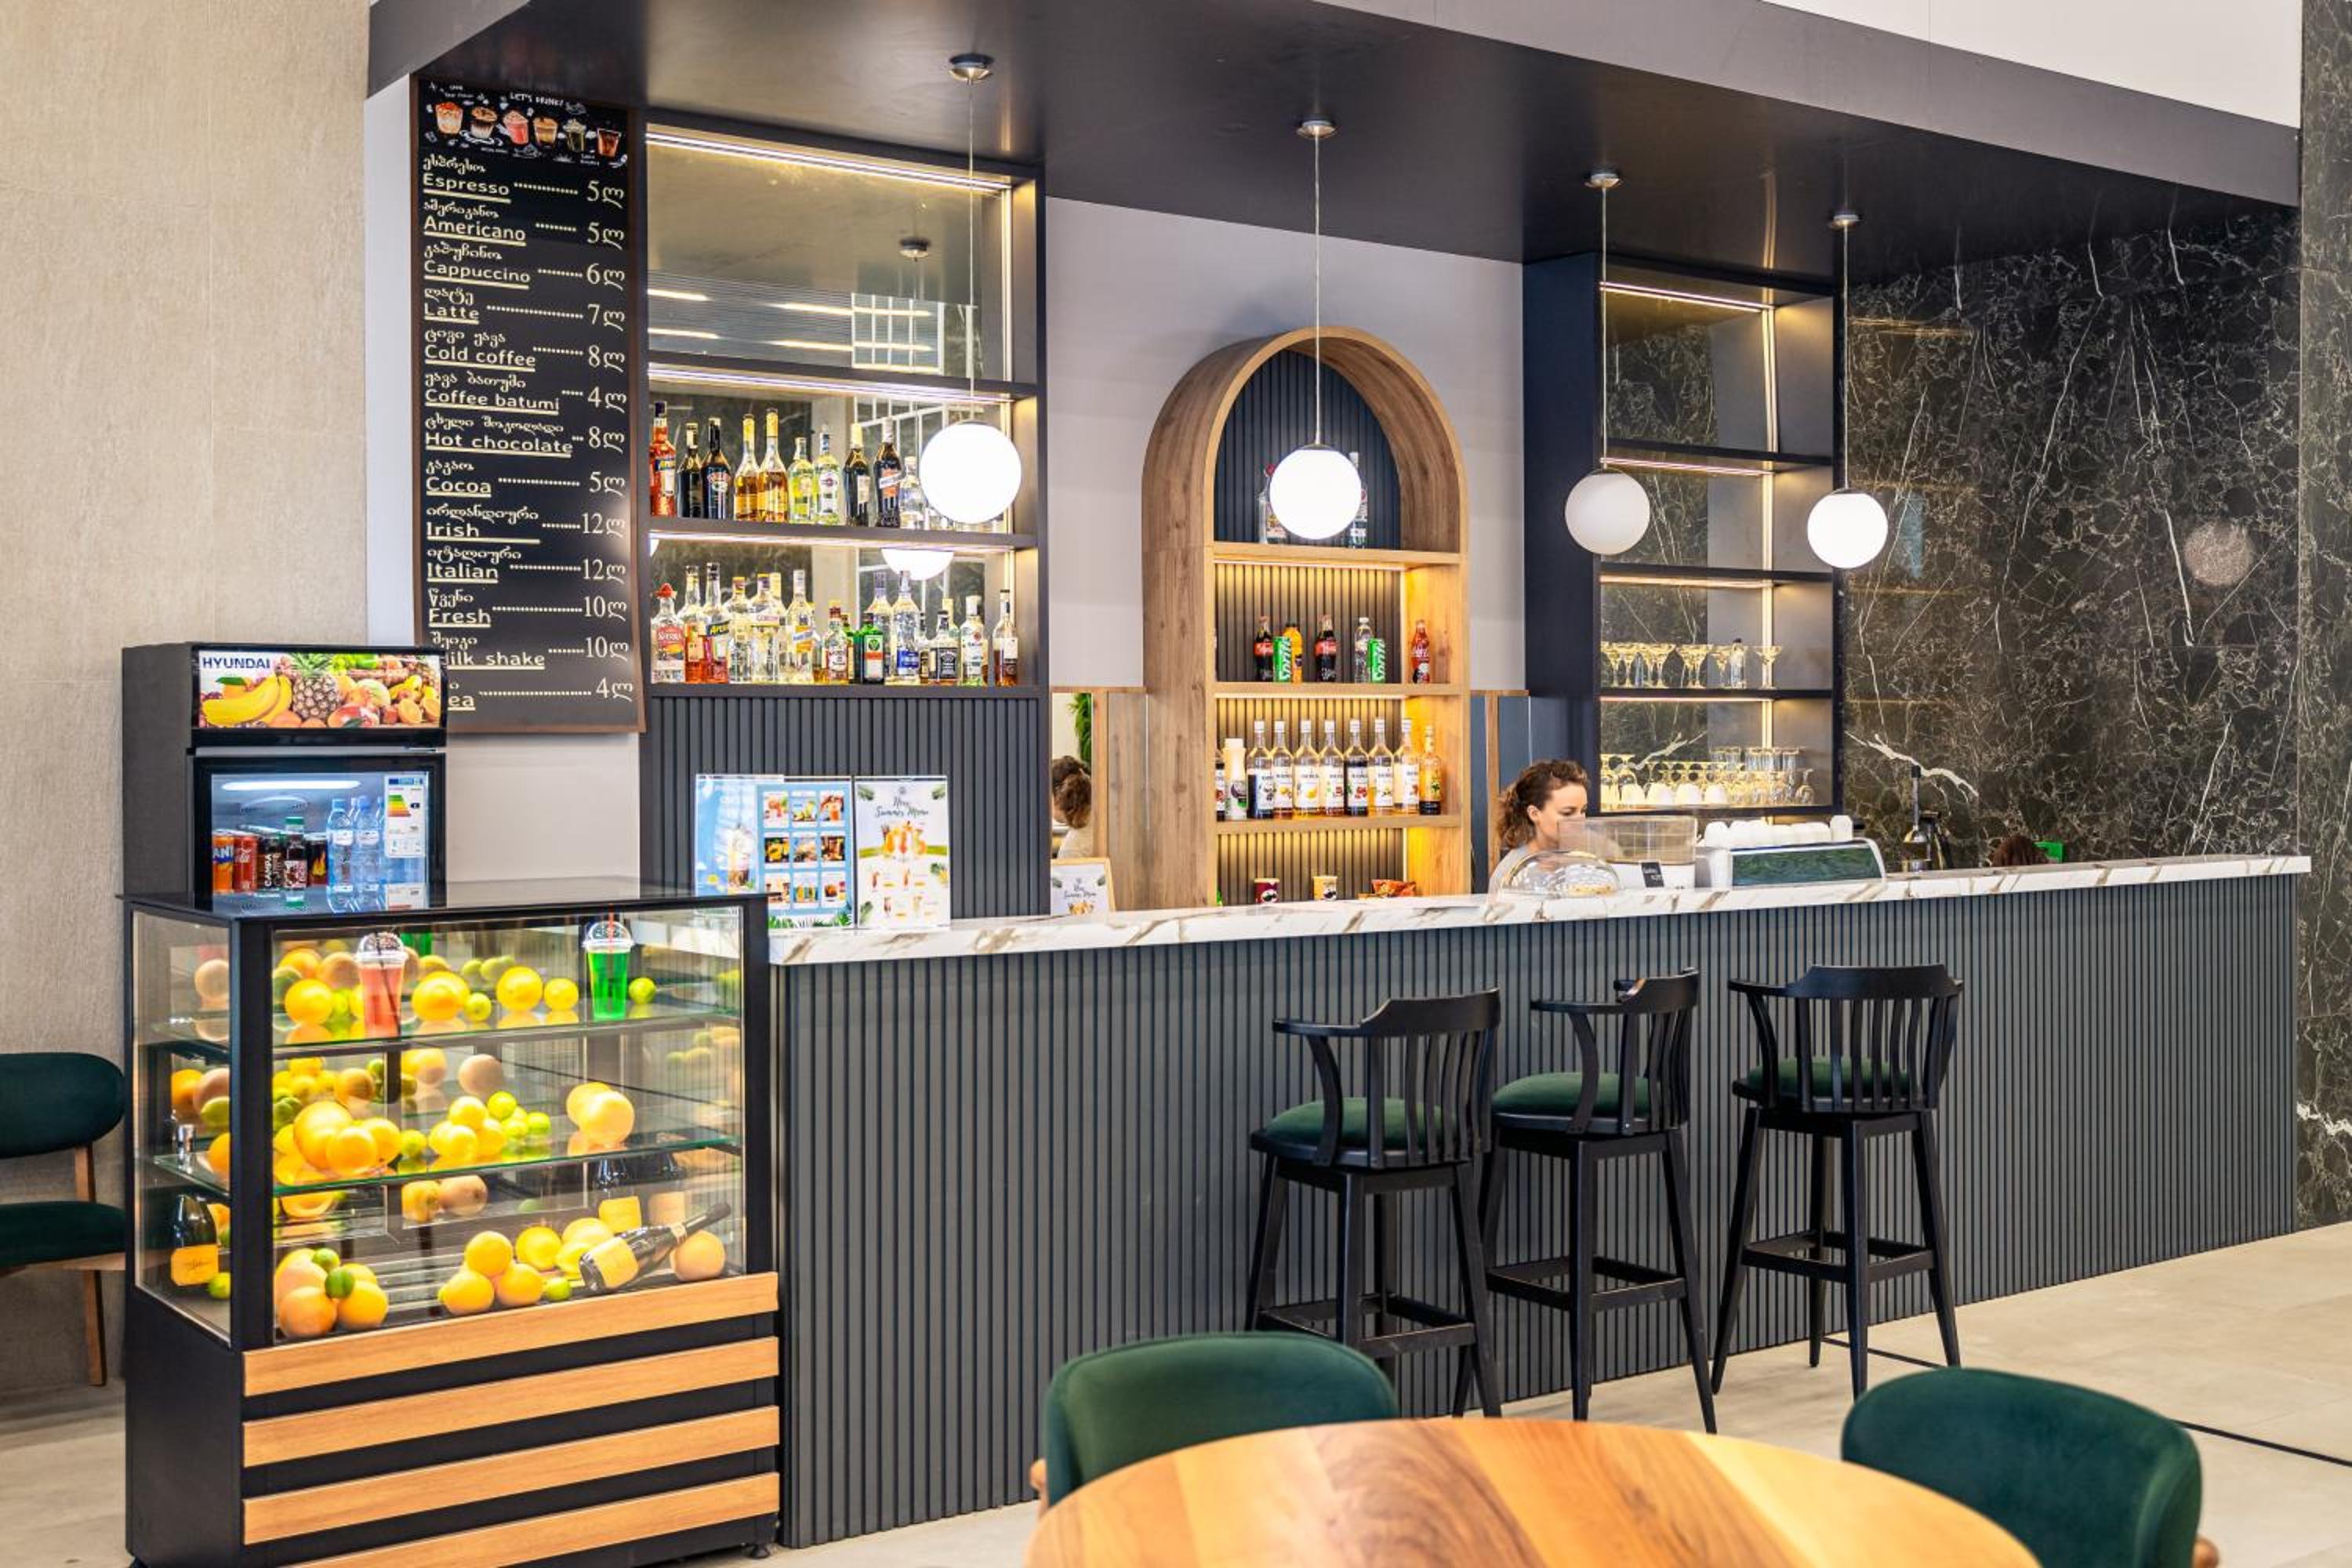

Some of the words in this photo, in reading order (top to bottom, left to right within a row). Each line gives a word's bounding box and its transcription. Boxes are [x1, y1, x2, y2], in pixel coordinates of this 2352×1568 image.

[423, 172, 510, 195] Espresso
[424, 216, 526, 241] Americano
[424, 260, 530, 282] Cappuccino
[424, 287, 474, 306] ლატე
[424, 303, 479, 319] Latte
[425, 329, 465, 344] ცივი
[474, 332, 506, 347] ყავა
[425, 344, 467, 361] Cold
[476, 350, 535, 366] coffee
[425, 372, 458, 388] ყავა
[425, 389, 488, 405] Coffee
[495, 394, 559, 410] batumi
[426, 432, 463, 446] Hot
[471, 434, 573, 453] chocolate
[426, 477, 492, 492] Cocoa
[426, 521, 479, 536] Irish
[427, 562, 498, 578] Italian
[429, 608, 492, 623] Fresh
[202, 657, 271, 670] HYUNDAI
[485, 652, 545, 666] shake
[448, 695, 474, 706] ea
